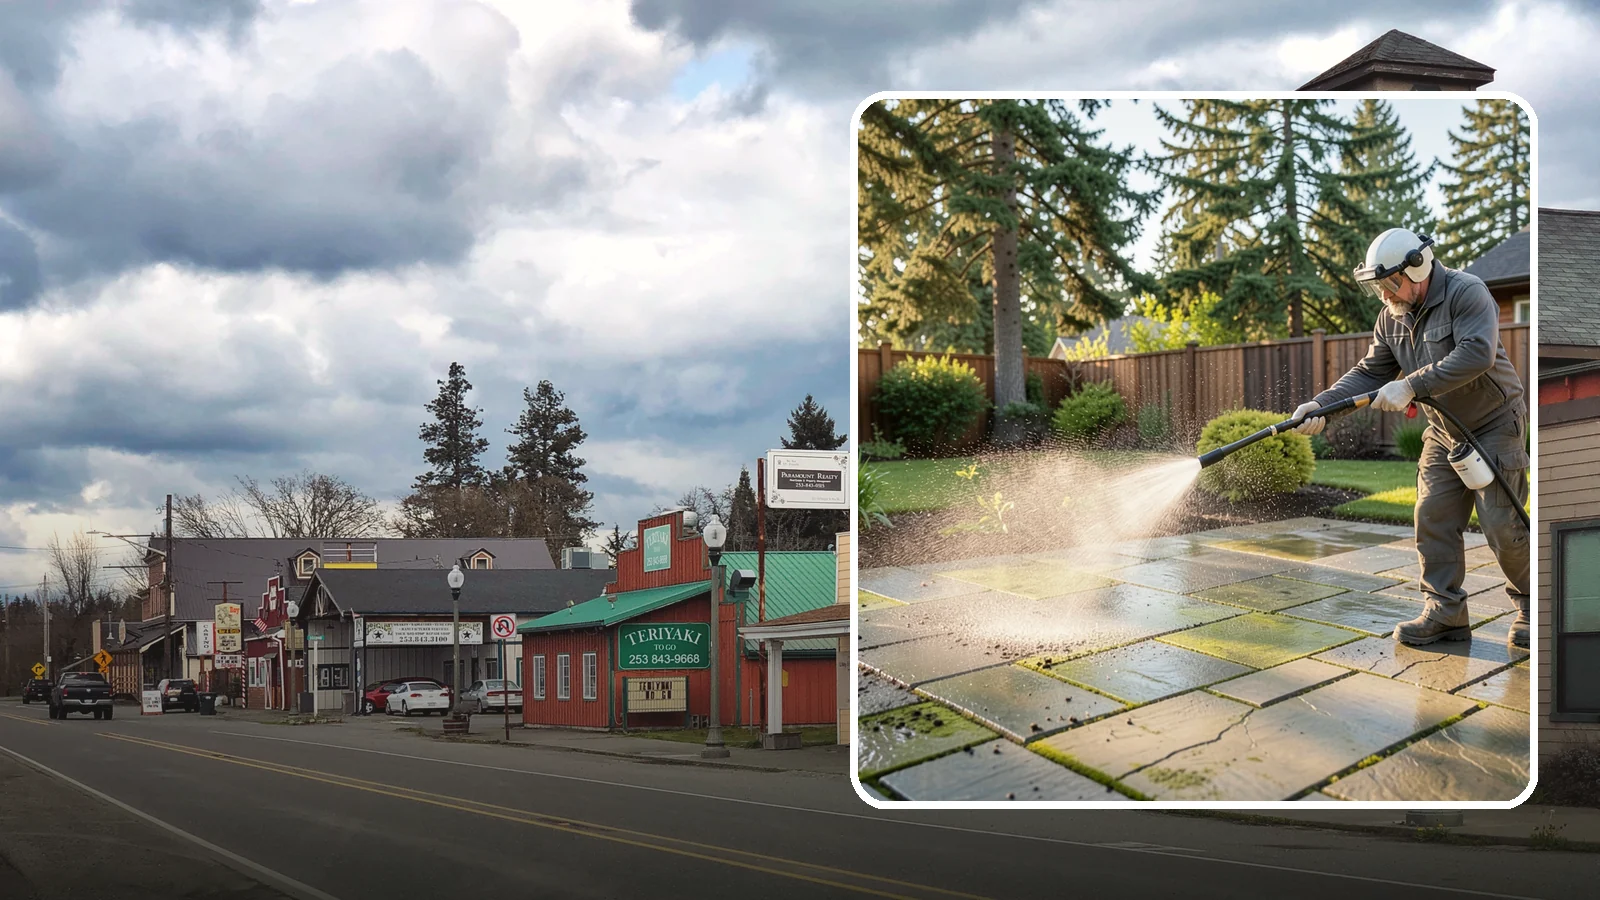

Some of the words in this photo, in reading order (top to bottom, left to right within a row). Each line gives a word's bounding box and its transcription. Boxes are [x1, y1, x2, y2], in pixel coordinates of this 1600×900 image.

[817, 472, 839, 480] REALTY
[624, 627, 703, 646] TERIYAKI
[653, 643, 665, 651] TO
[665, 643, 677, 651] GO
[628, 654, 649, 665] 253
[651, 653, 700, 664] 843-9668
[639, 681, 672, 691] TERIYAKI
